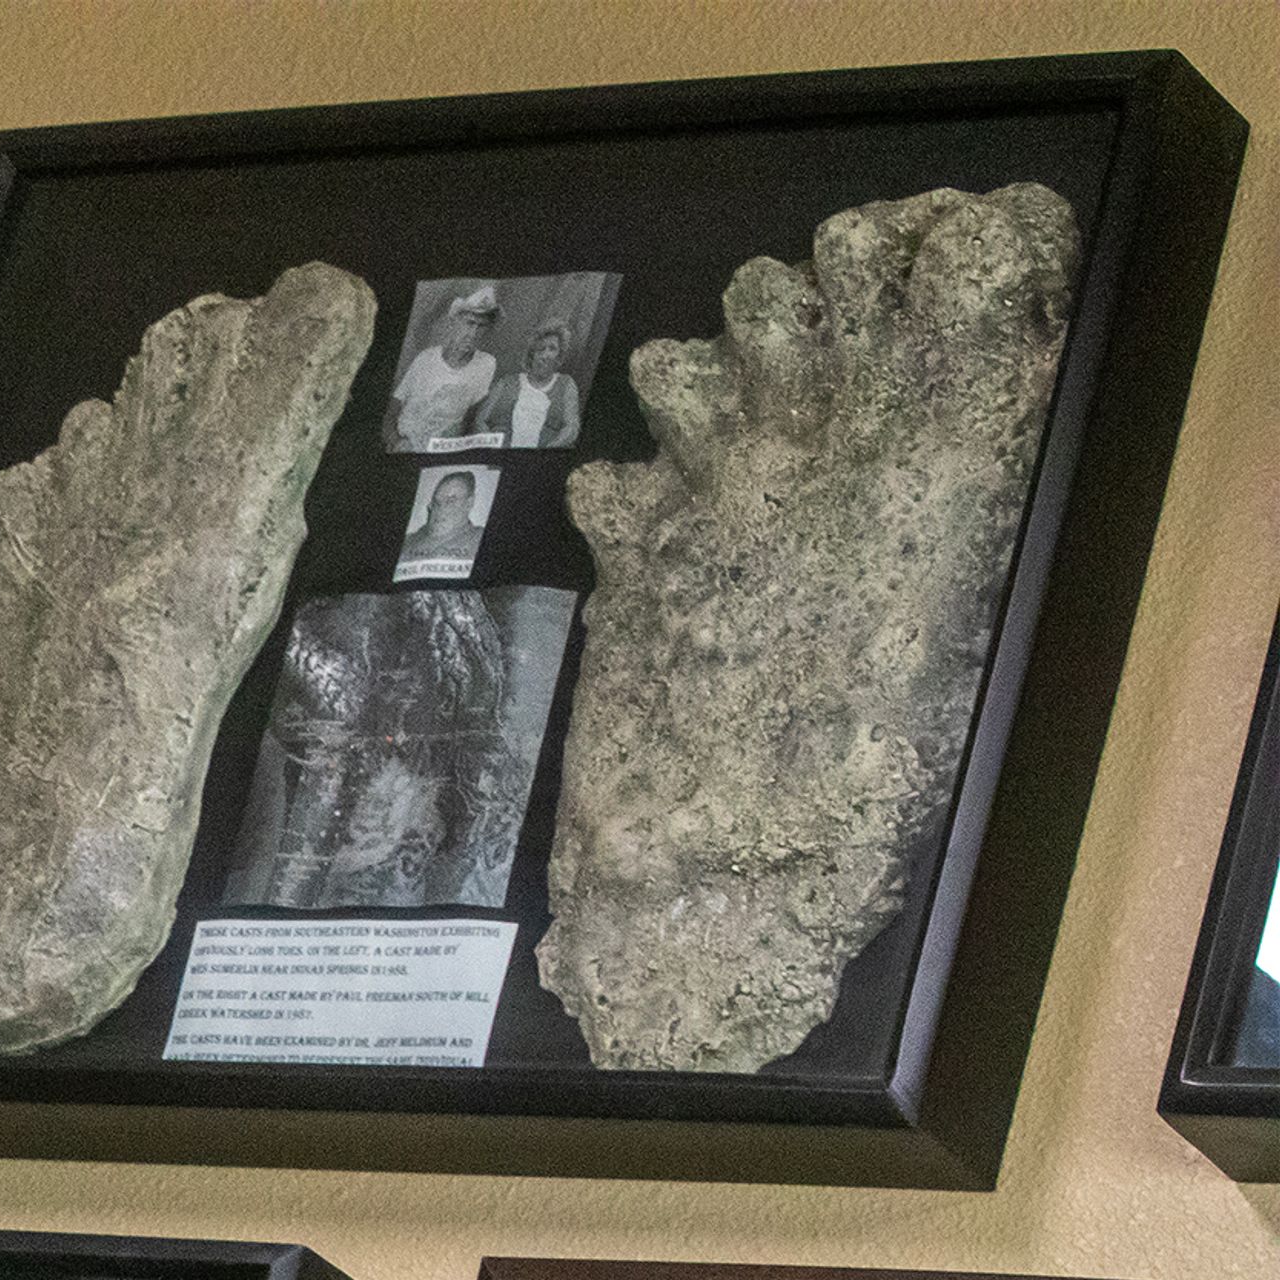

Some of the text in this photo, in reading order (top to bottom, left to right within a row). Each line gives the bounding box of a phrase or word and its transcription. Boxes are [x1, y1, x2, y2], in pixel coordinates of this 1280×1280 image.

[230, 927, 263, 937] CASTS
[265, 927, 291, 937] FROM
[374, 927, 438, 937] WASHINGTON
[384, 946, 412, 956] CAST
[413, 946, 442, 956] MADE
[250, 990, 258, 1000] A
[259, 990, 287, 1000] CAST
[290, 991, 318, 1001] MADE
[320, 990, 336, 1001] BY
[337, 991, 363, 1001] PAUL
[366, 991, 413, 1002] FREEMAN
[415, 991, 448, 1002] SOUTH
[210, 1008, 272, 1019] WATERSHED
[274, 1009, 284, 1019] IN
[190, 1034, 221, 1044] CASTS
[223, 1034, 253, 1045] HAVE
[255, 1035, 282, 1046] BEEN
[284, 1036, 337, 1047] EXAMINED
[339, 1037, 354, 1047] BY
[449, 1038, 473, 1048] AND
